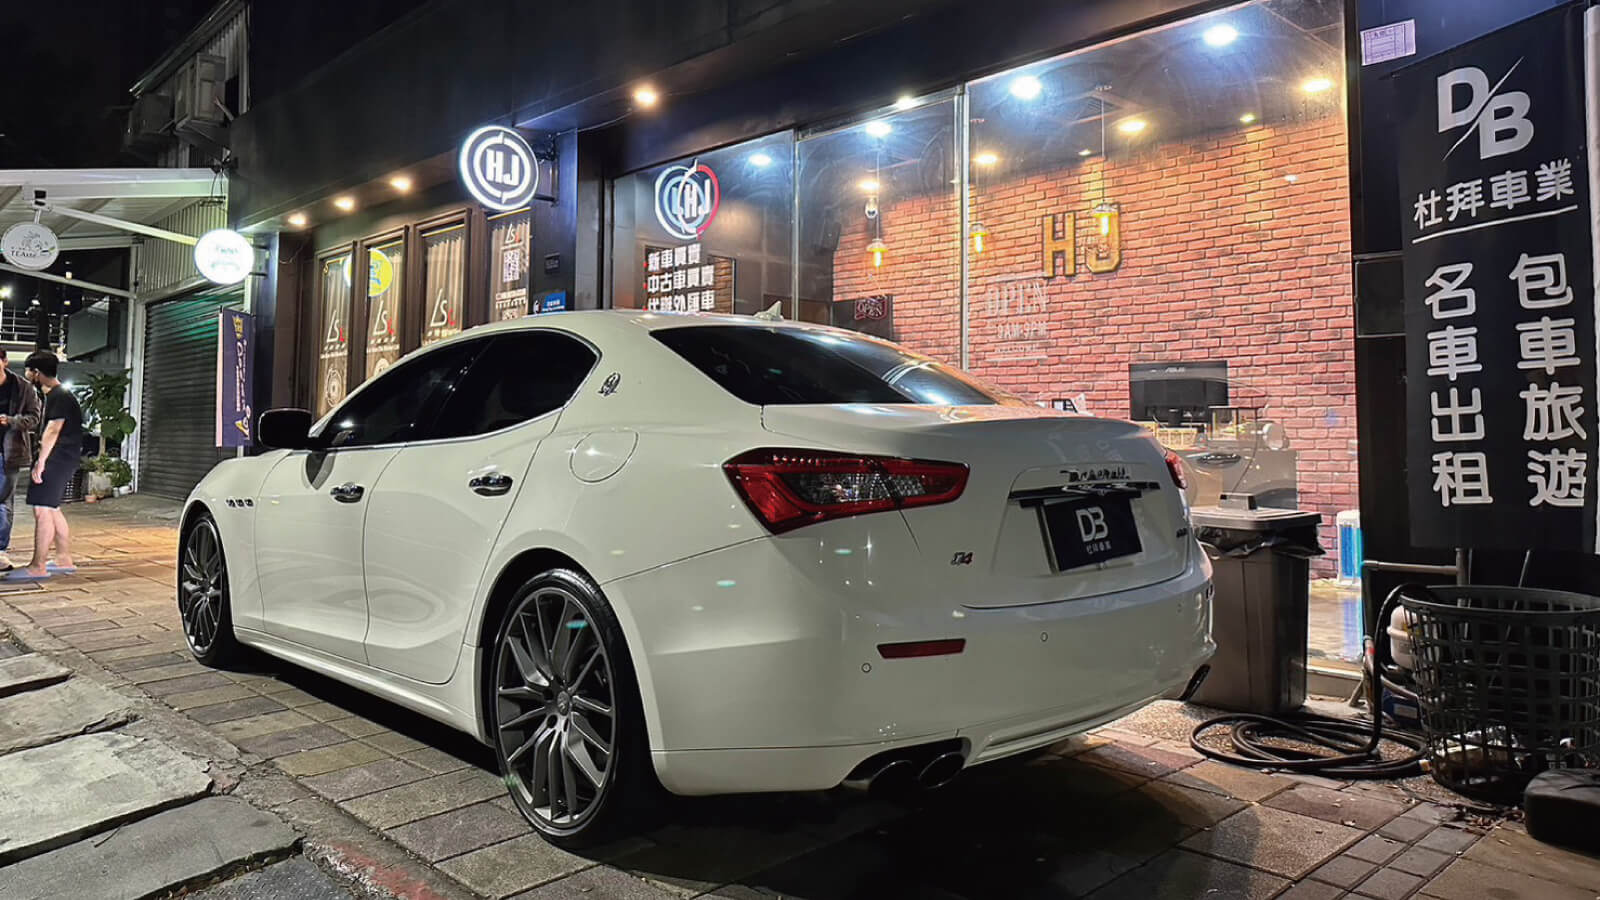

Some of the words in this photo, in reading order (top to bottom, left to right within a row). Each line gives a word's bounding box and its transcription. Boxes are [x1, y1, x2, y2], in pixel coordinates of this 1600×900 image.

[486, 148, 520, 186] HJ
[1413, 157, 1575, 230] 杜拜車業
[1042, 204, 1122, 277] HJ
[857, 302, 883, 317] OPEN
[1424, 261, 1494, 507] 名車出租
[1509, 251, 1588, 508] 包車旅遊
[1075, 506, 1109, 542] DB
